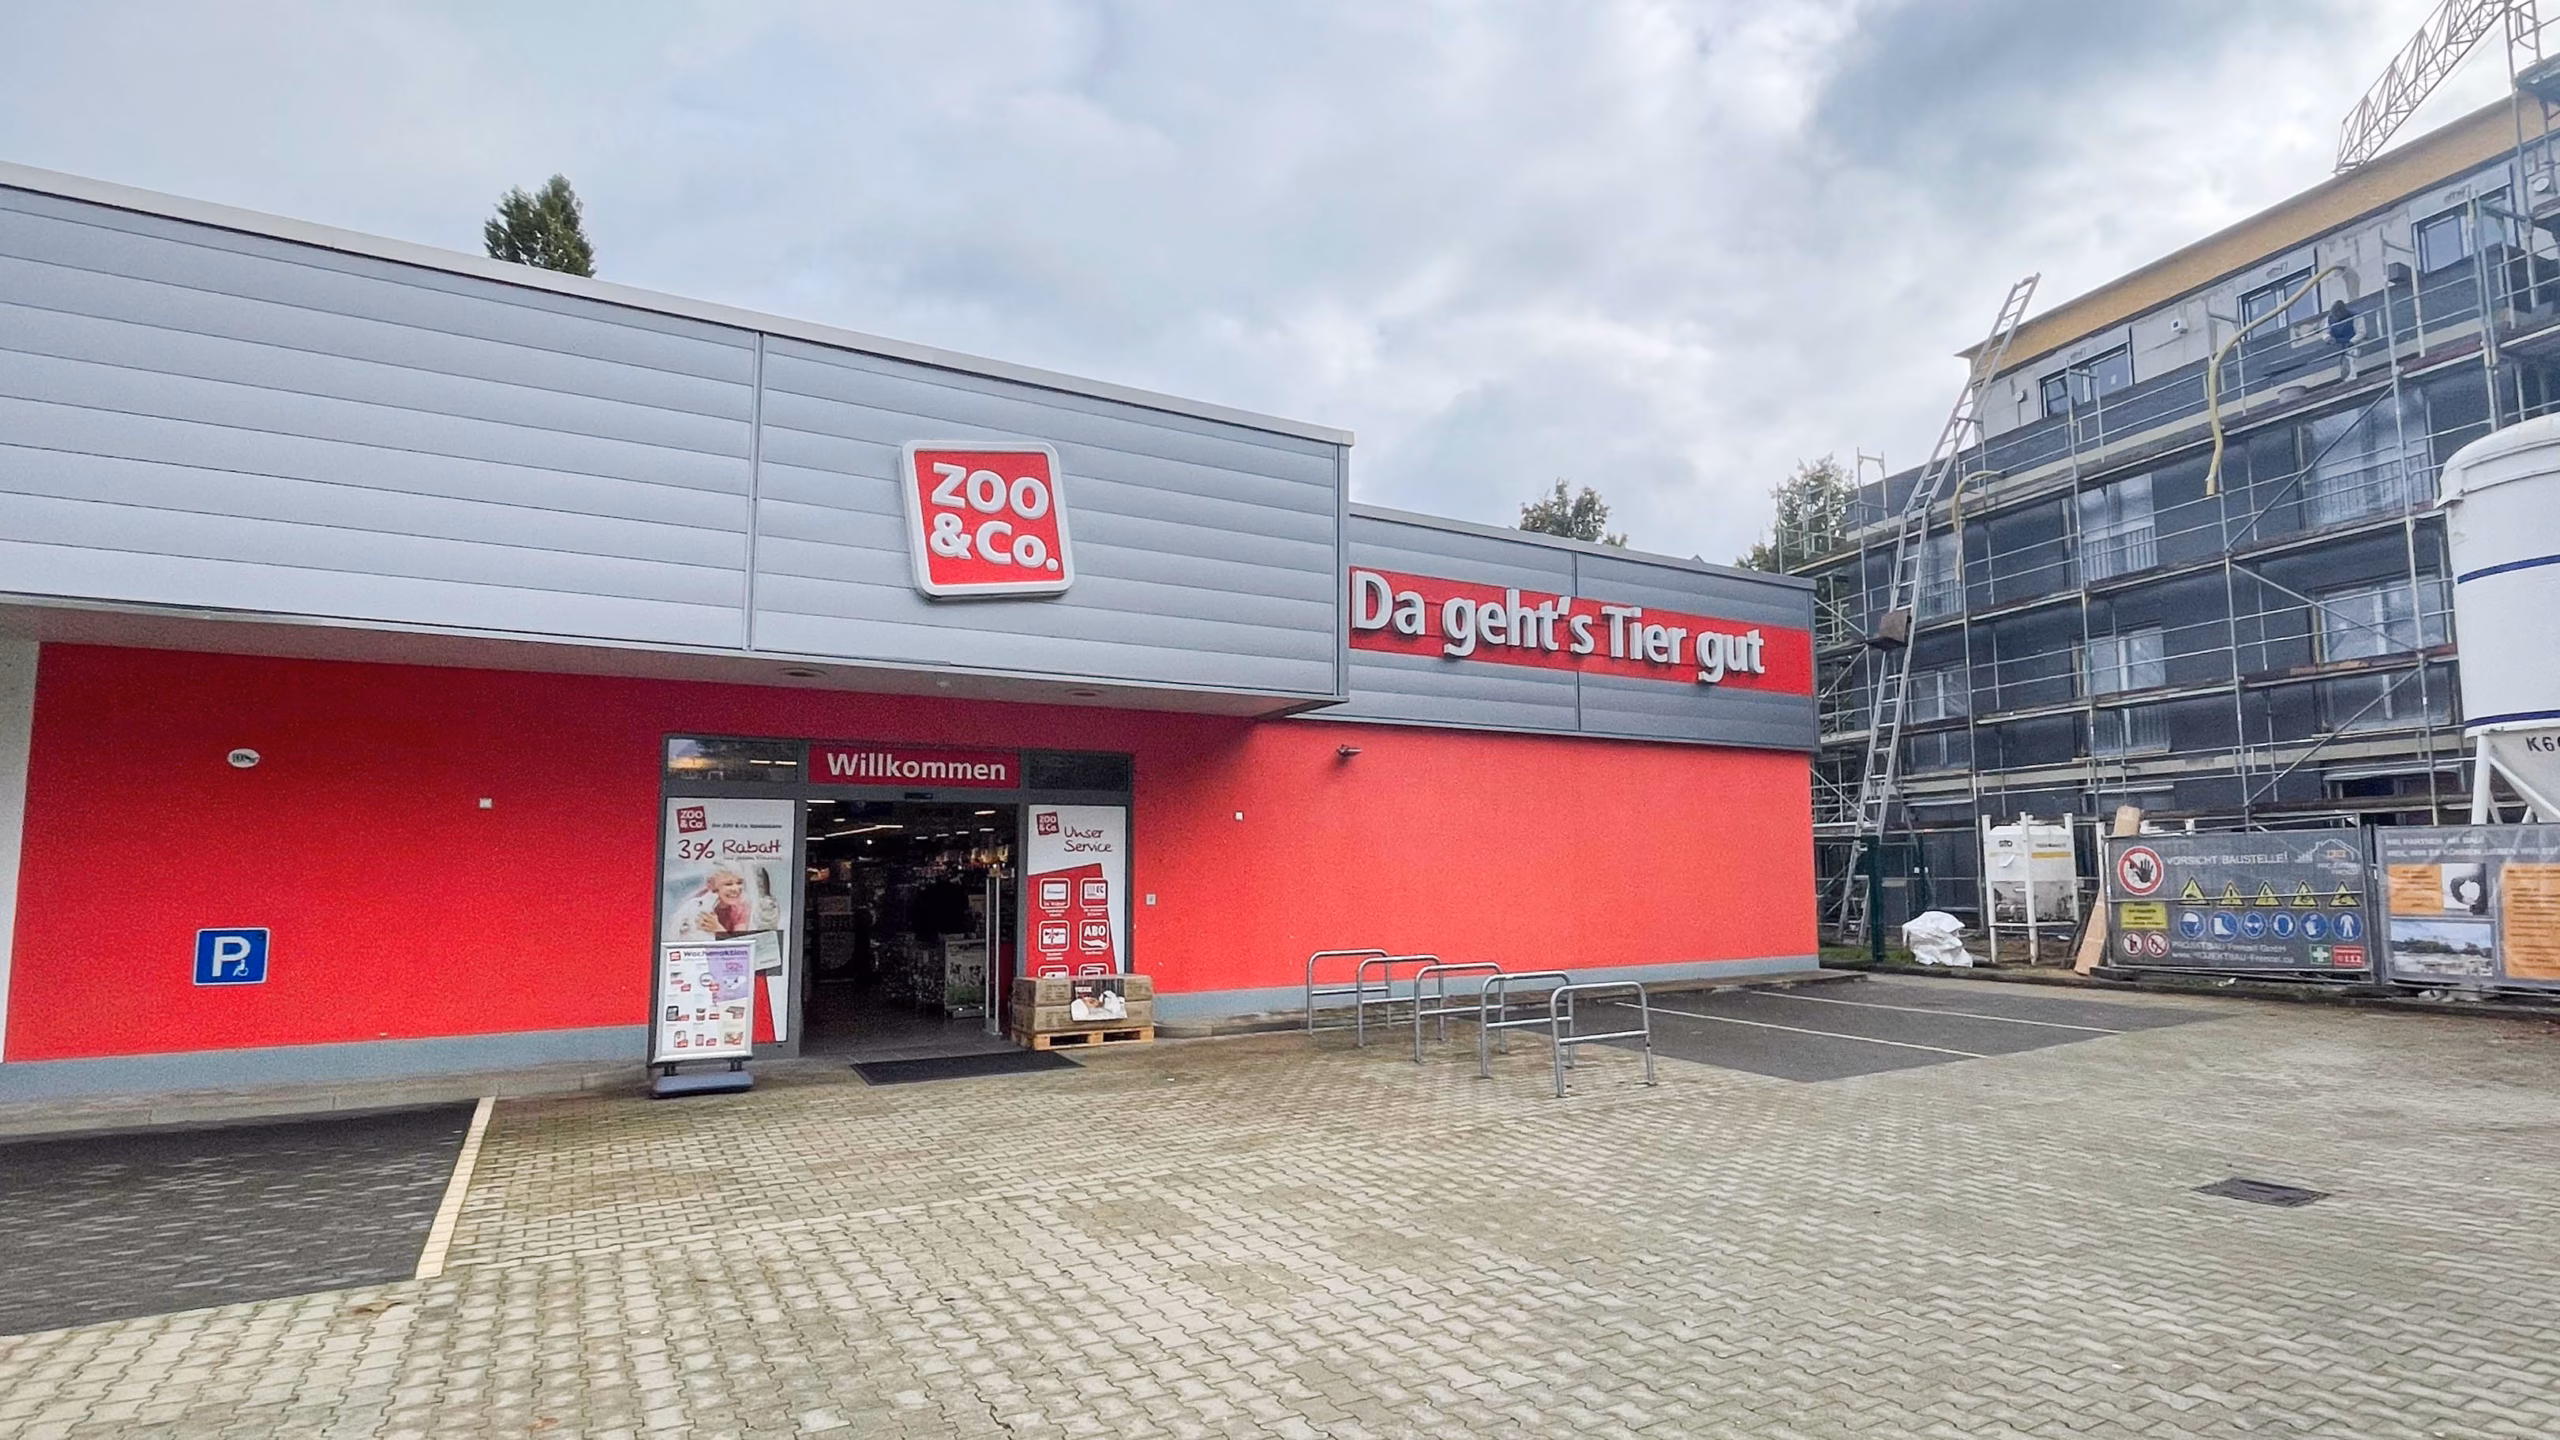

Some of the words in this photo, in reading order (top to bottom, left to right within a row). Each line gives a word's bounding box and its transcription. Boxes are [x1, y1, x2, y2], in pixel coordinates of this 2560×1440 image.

[931, 462, 1049, 520] ZOO
[1352, 570, 1426, 635] Da
[1601, 605, 1687, 664] Tier
[1696, 629, 1766, 683] gut
[2526, 736, 2560, 752] K6
[827, 752, 1006, 780] Willkommen
[680, 810, 703, 819] ZOO
[1039, 815, 1057, 824] ZOO
[1064, 826, 1104, 838] Unser
[678, 838, 715, 860] 3%
[722, 839, 781, 854] Rabatt
[1064, 840, 1113, 852] Service
[2166, 855, 2218, 865] VORSICHT
[2222, 851, 2289, 865] BAUSTELLE!
[1084, 926, 1106, 937] ABO
[212, 936, 251, 977] P
